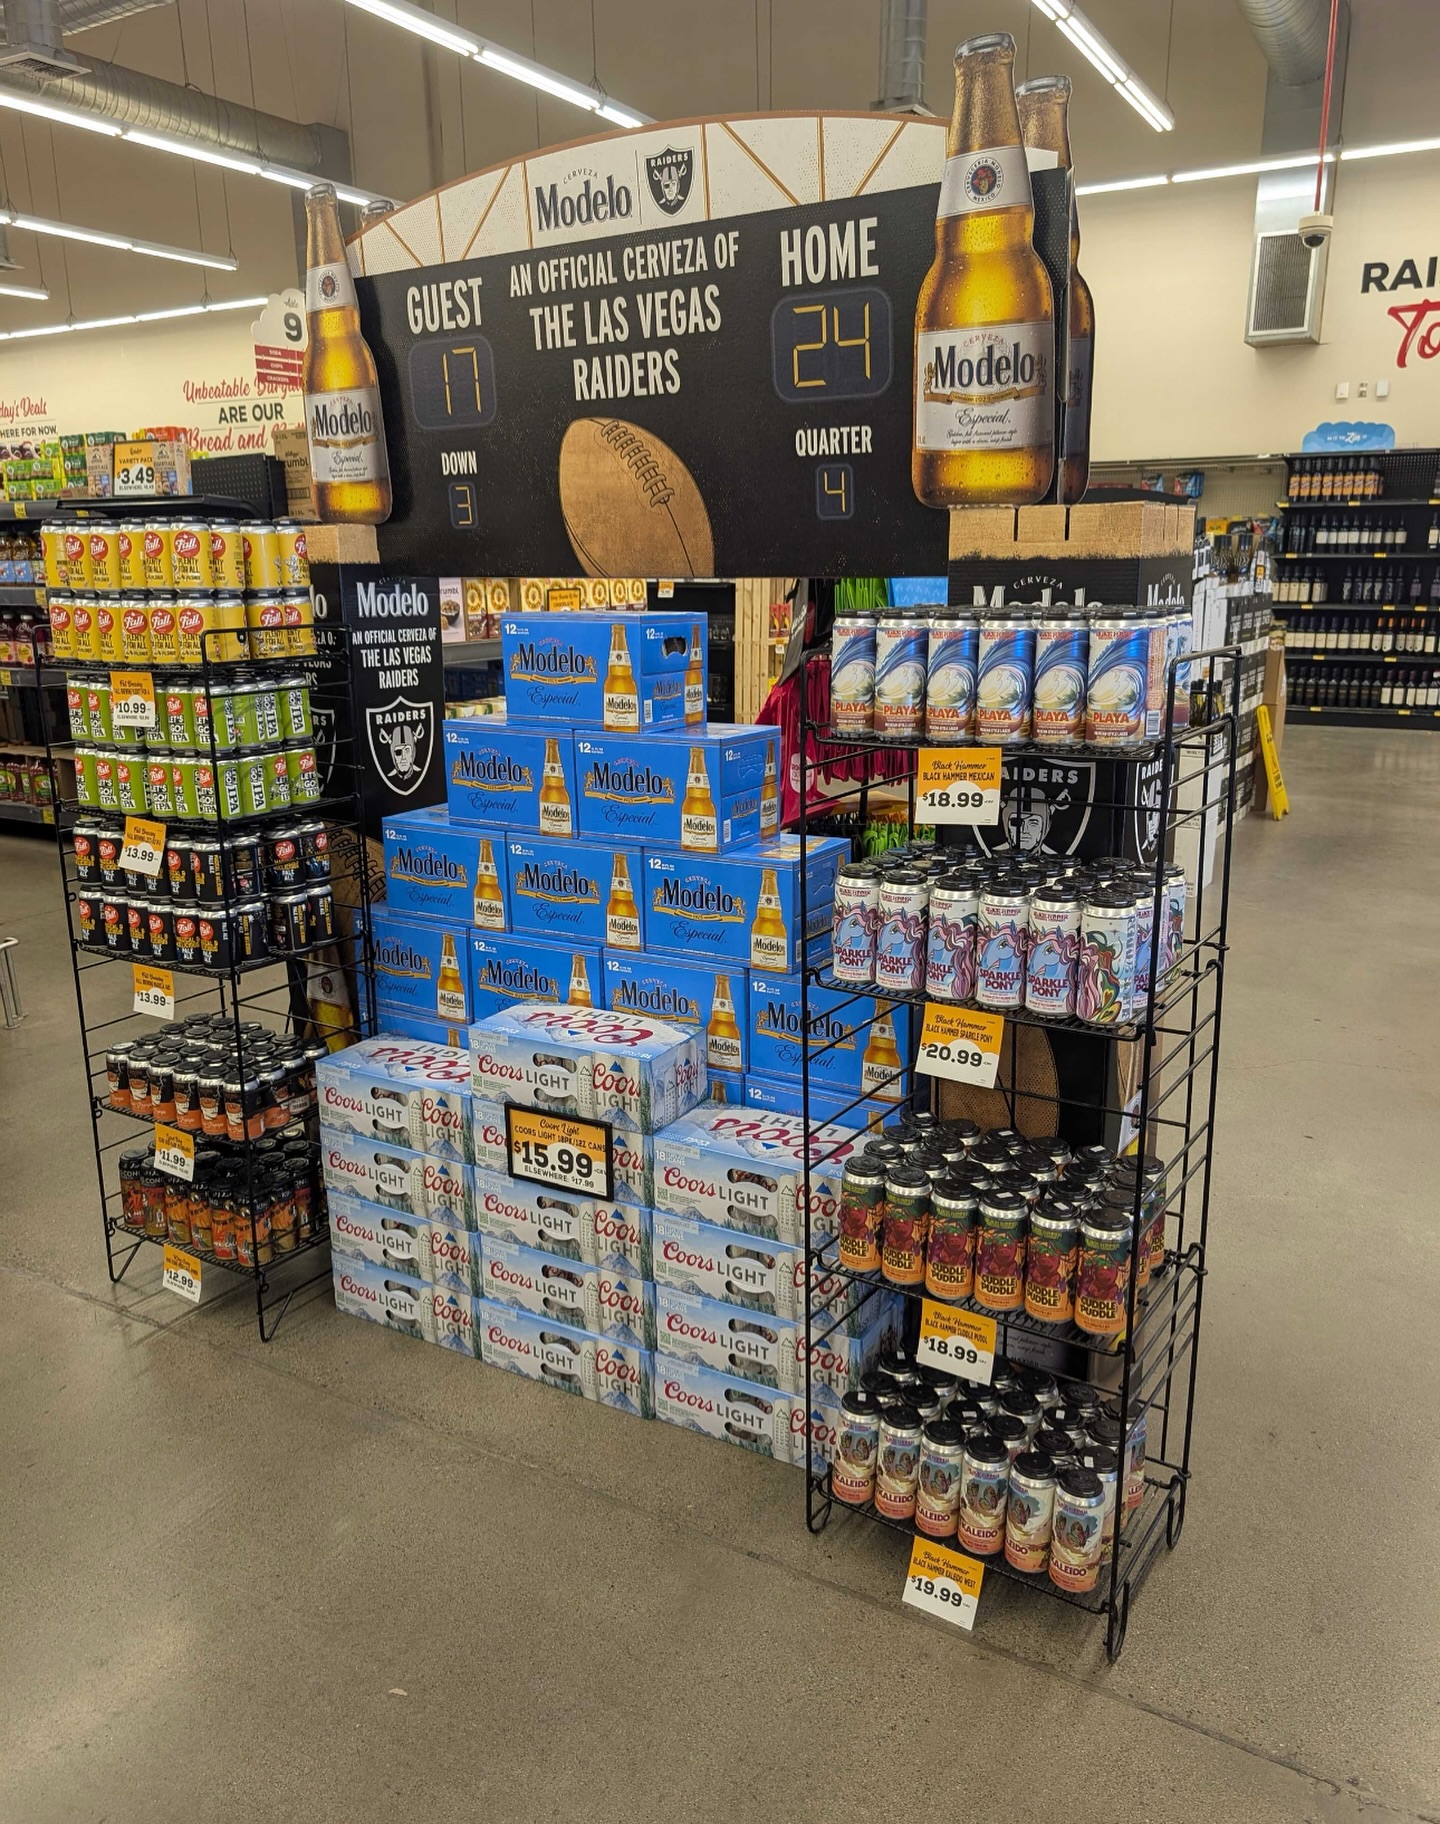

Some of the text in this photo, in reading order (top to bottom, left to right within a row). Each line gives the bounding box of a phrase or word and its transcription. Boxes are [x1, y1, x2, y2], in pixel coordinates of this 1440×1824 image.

[650, 153, 689, 168] RAIDERS
[563, 168, 599, 186] CERVEZA
[535, 176, 633, 232] Modelo
[510, 231, 740, 297] AN OFFICIAL CERVEZA OF
[780, 217, 880, 287] HOME
[406, 278, 483, 334] GUEST
[529, 285, 723, 351] THE LAS VEGAS
[284, 312, 302, 342] 9
[792, 303, 871, 388] 24
[964, 334, 1006, 347] CERVEZA
[573, 348, 682, 401] RAIDERS
[935, 342, 1034, 388] Modelo
[183, 377, 250, 401] Unbeatable
[442, 346, 482, 416] 17
[20, 396, 47, 418] Deals
[218, 402, 284, 424] ARE OUR
[315, 403, 372, 436] Modelo
[21, 427, 36, 437] FOR
[187, 426, 234, 451] Bread
[238, 425, 268, 450] and
[795, 425, 873, 457] QUARTER
[441, 450, 478, 476] DOWN
[823, 471, 846, 513] 4
[454, 486, 473, 525] 3
[175, 537, 198, 553] Fall
[178, 558, 199, 566] PLENTY
[189, 565, 200, 573] ALL
[1013, 575, 1064, 591] CERVEZA
[356, 581, 429, 619] Modelo
[352, 627, 437, 645] AN OFFICIAL CERVEZA OF
[505, 624, 517, 635] 12
[361, 645, 432, 668] THE LAS VEGAS
[519, 643, 585, 674] Modelo
[379, 668, 419, 689] RAIDERS
[607, 697, 635, 710] Modelo
[835, 702, 867, 713] PLAYA
[980, 708, 1013, 721] PLAYA
[375, 709, 427, 725] RAIDERS
[1093, 711, 1129, 723] PLAYA
[172, 733, 188, 742] IPA
[578, 742, 592, 754] 12
[460, 751, 522, 783] Modelo
[923, 771, 995, 781] BLACK HAMMER MEXICAN
[932, 760, 987, 771] Black Hammer
[593, 761, 663, 795] Modelo
[922, 792, 984, 808] $18.99
[398, 848, 457, 879] Modelo
[648, 857, 662, 871] 12
[524, 862, 589, 896] Modelo
[663, 878, 734, 914] Modelo
[834, 946, 873, 959] SPARKLE
[839, 956, 865, 968] PONY
[487, 959, 549, 993] Modelo
[980, 968, 1021, 980] SPARKLE
[985, 980, 1015, 990] PONY
[620, 979, 689, 1014] Modelo
[926, 1023, 993, 1043] BLACK HAMMER SPARKLE PONY
[935, 1014, 987, 1031] Black Hammer
[921, 1042, 982, 1067] $20.99
[478, 1053, 569, 1092] Coors LIGHT
[592, 1058, 641, 1097] Coors
[324, 1086, 402, 1123] Coors LIGHT
[515, 1125, 536, 1136] COORS
[538, 1129, 555, 1141] LIGHT
[588, 1141, 606, 1152] CANS
[560, 1122, 580, 1137] Light
[514, 1140, 592, 1178] $15.99
[656, 1150, 666, 1161] 18
[328, 1150, 405, 1189] Coors LIGHT
[663, 1166, 769, 1210] Coors LIGHT
[484, 1192, 573, 1234] Coors LIGHT
[662, 1240, 767, 1287] Coors LIGHT
[932, 1262, 967, 1275] CUDDLE
[932, 1272, 966, 1284] PUDDLE
[1080, 1306, 1116, 1319] PUDDLE
[1081, 1296, 1116, 1310] CUDDLE
[925, 1318, 938, 1329] BLACK
[940, 1322, 957, 1334] HAMMER
[957, 1327, 974, 1340] CUDDLE
[933, 1311, 982, 1331] Black Hammer
[488, 1325, 574, 1370] Coors LIGHT
[666, 1312, 769, 1360] Coors LIGHT
[923, 1335, 978, 1364] $18.99
[961, 1526, 998, 1539] KALEIDO
[913, 1556, 926, 1569] BLACK
[926, 1562, 945, 1576] HAMMER
[963, 1577, 976, 1589] WEST
[923, 1550, 969, 1575] Black Hammer
[1051, 1560, 1087, 1577] KALEIDO
[911, 1574, 963, 1607] $19.99
